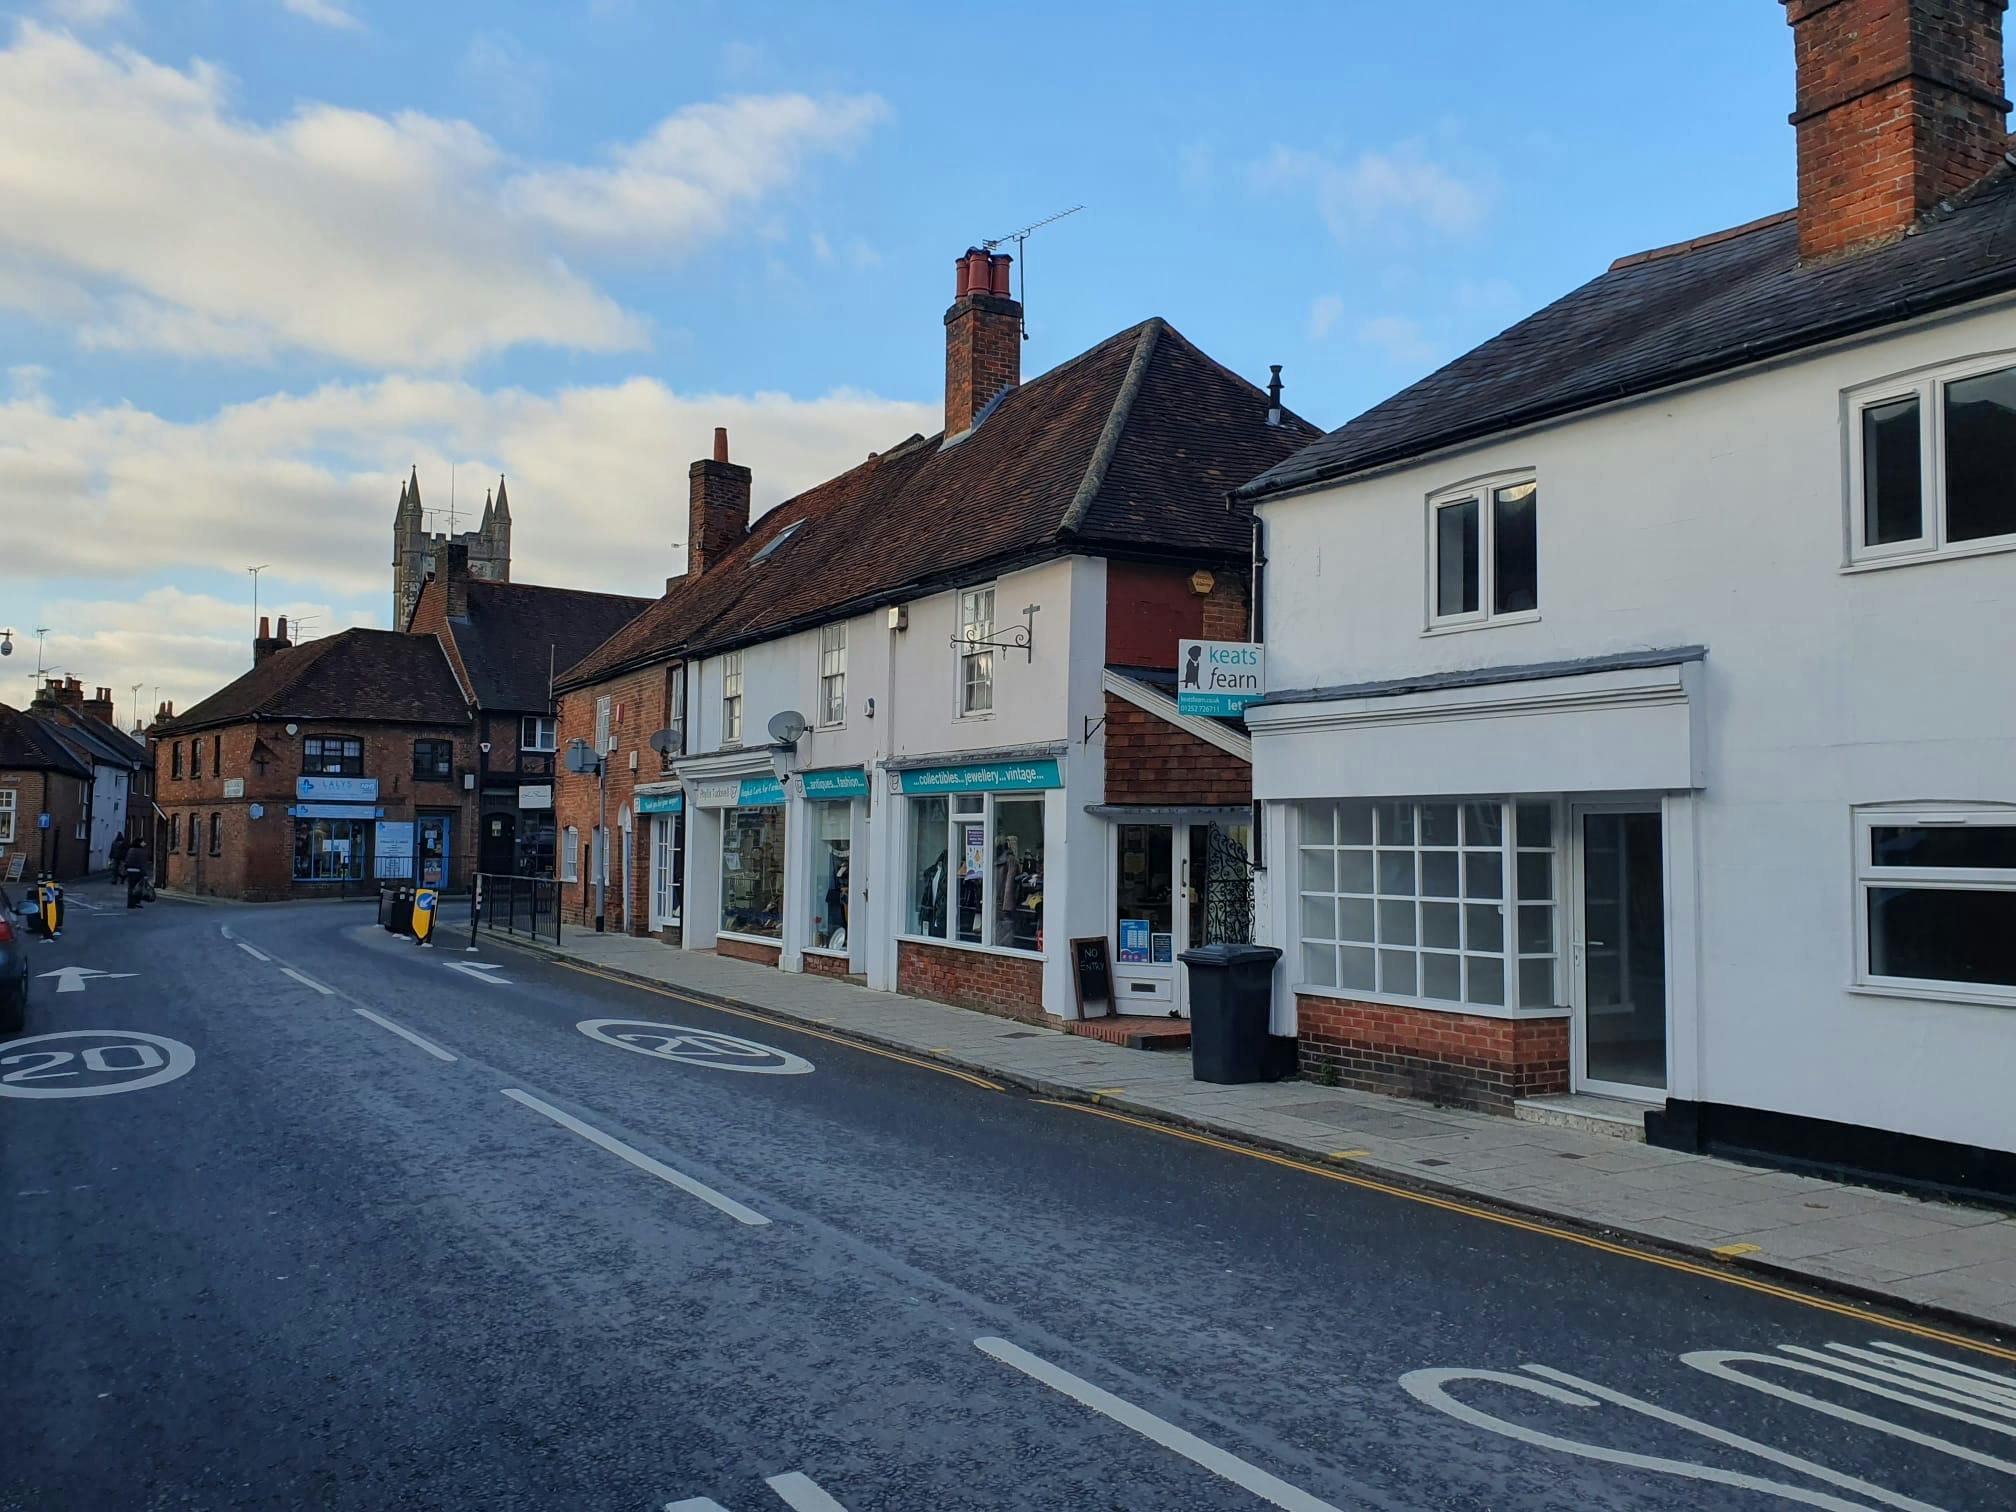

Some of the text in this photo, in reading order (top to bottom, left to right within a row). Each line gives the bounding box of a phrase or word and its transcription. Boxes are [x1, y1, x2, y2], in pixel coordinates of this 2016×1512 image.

[1209, 646, 1257, 665] keats
[1209, 667, 1257, 690] fearn
[1085, 948, 1098, 958] NO
[0, 1044, 164, 1082] 20
